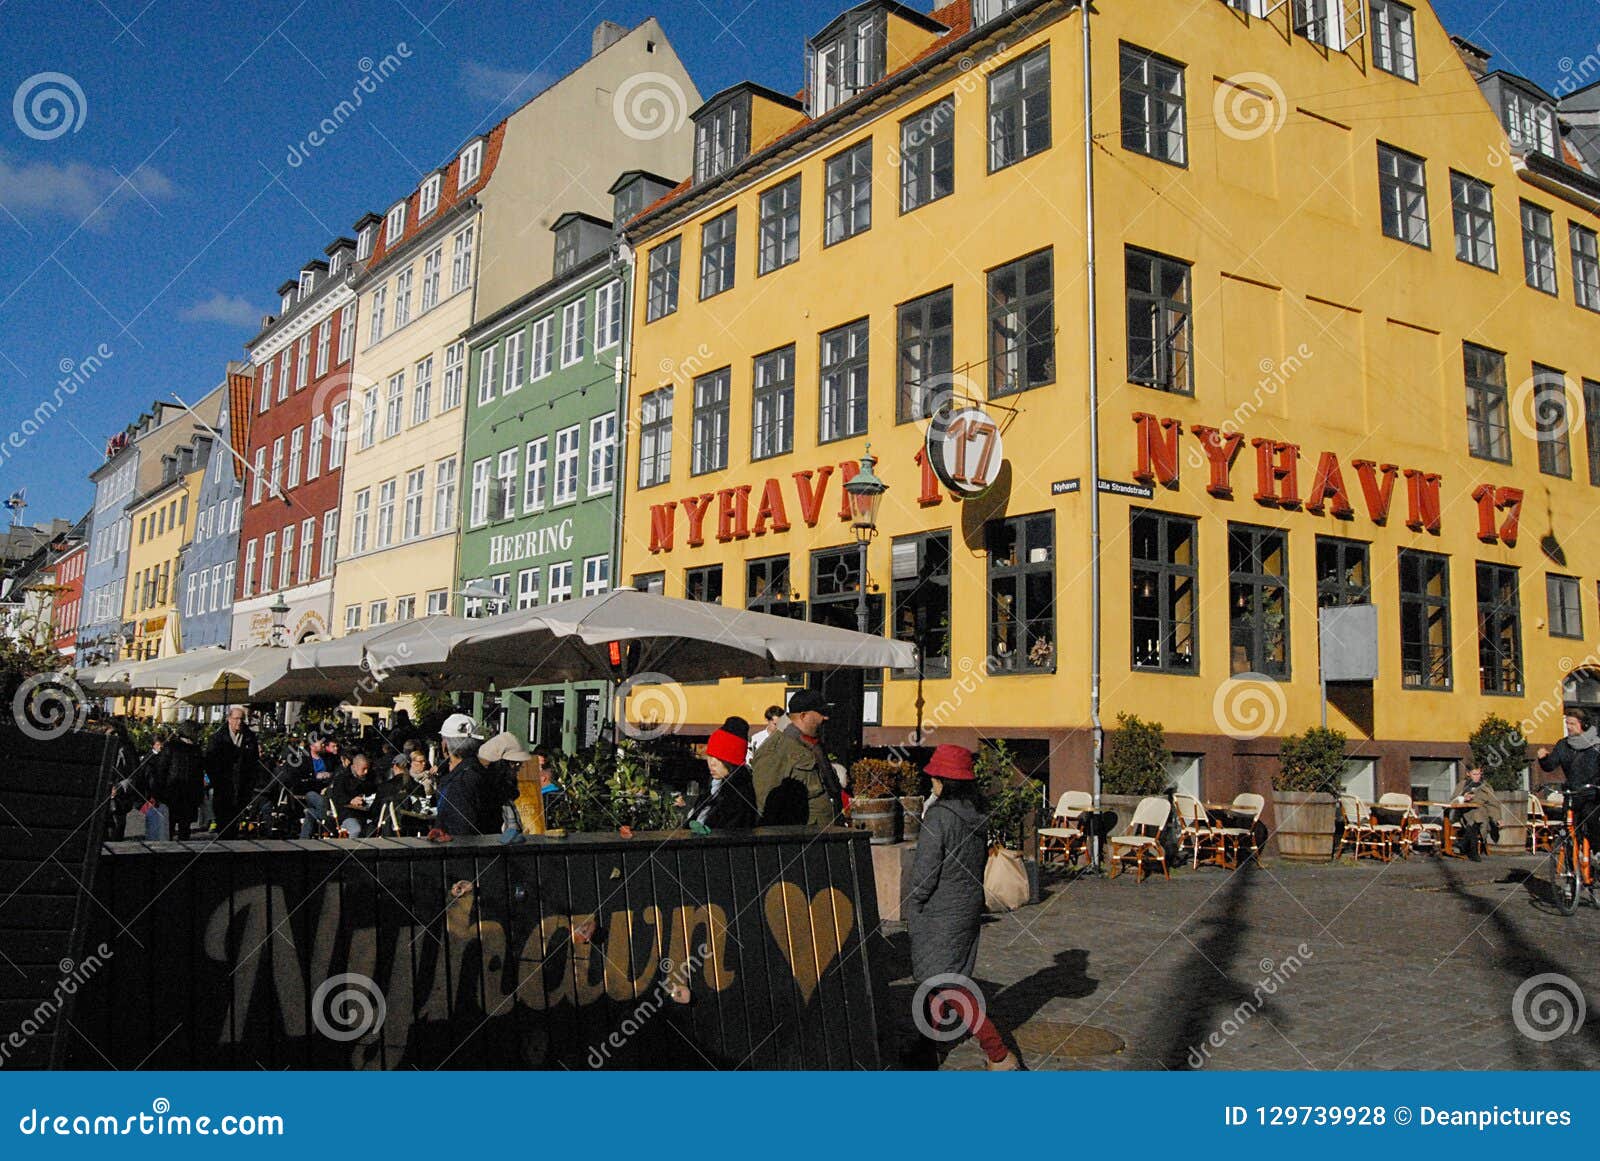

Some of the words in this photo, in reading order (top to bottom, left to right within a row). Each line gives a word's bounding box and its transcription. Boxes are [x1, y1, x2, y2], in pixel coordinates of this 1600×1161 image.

[945, 417, 997, 486] 17
[1132, 412, 1442, 536] NYHAVN
[1472, 484, 1524, 548] 17
[1054, 481, 1077, 493] Nyhavn
[489, 518, 574, 566] HEERING
[204, 881, 736, 1071] Nyhavn
